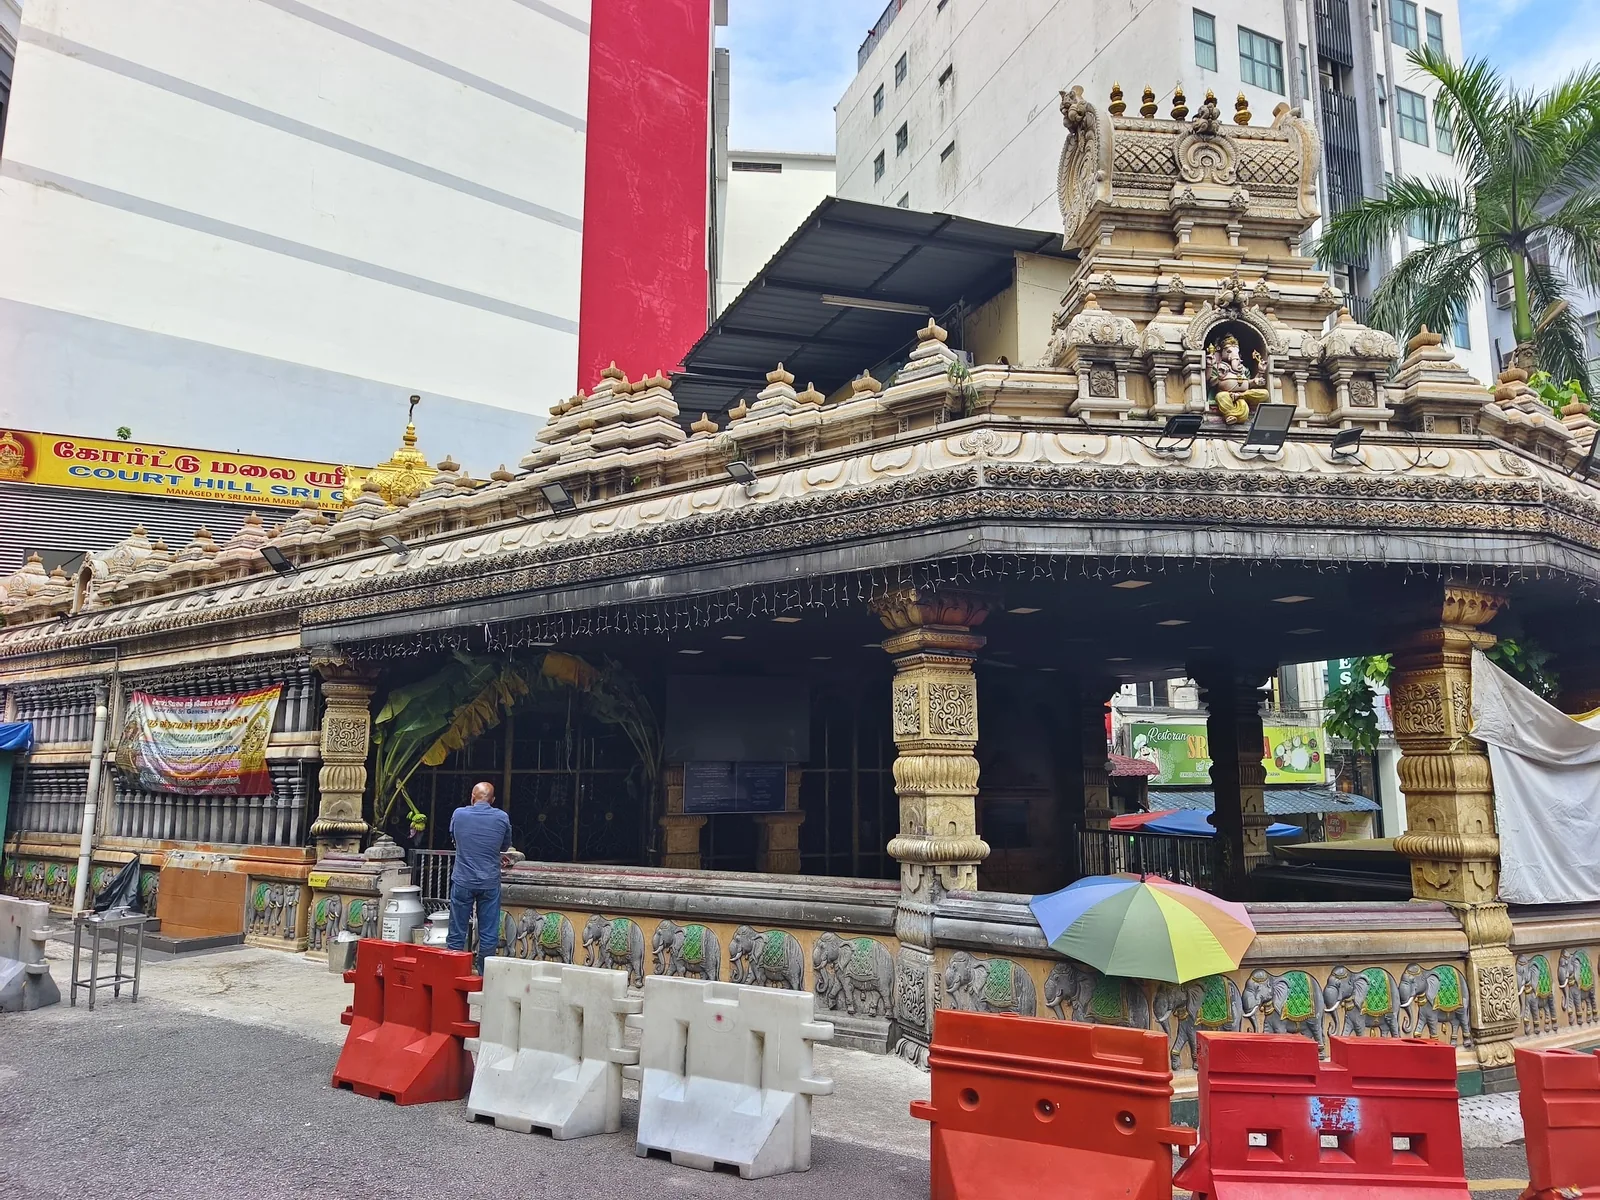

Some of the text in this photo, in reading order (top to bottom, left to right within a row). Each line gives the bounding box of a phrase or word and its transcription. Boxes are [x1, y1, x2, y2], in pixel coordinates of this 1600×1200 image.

[53, 441, 200, 473] கோர்ட்டு
[210, 461, 296, 481] மலை
[68, 466, 184, 486] COURT
[193, 477, 261, 493] HILL
[270, 485, 320, 499] SRI
[166, 488, 212, 498] MANAGED
[243, 495, 271, 503] MAHA
[1147, 726, 1186, 742] Restoran
